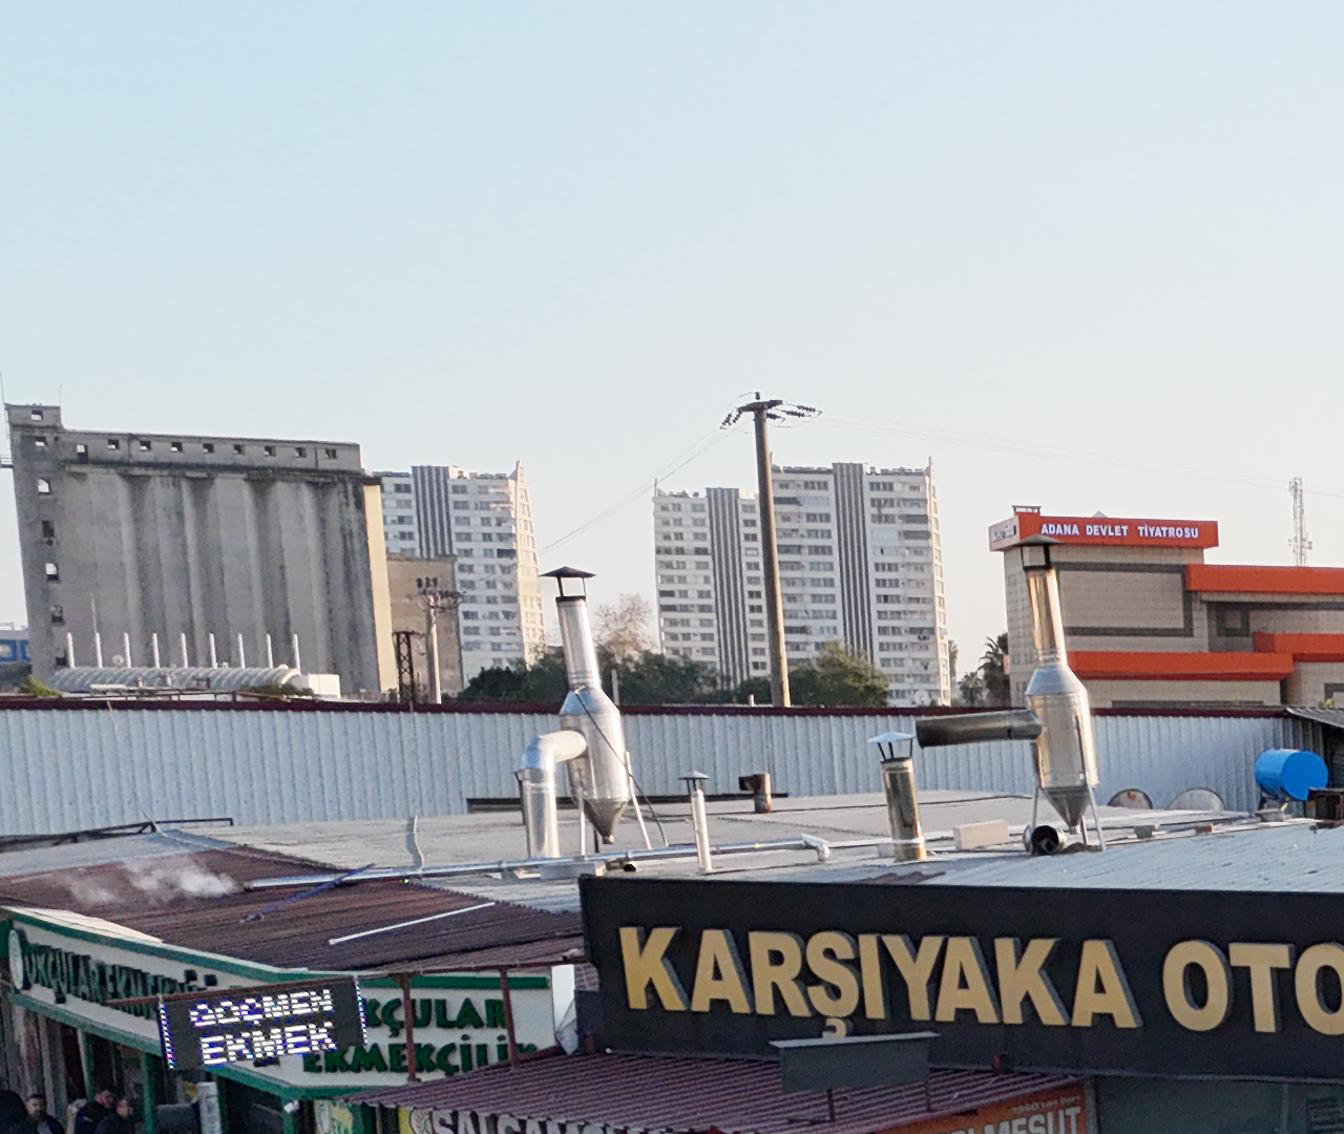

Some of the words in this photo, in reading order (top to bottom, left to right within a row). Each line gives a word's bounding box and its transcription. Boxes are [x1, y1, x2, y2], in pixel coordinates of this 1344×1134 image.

[1041, 523, 1080, 536] ADANA
[1086, 524, 1128, 537] DEVLET
[1138, 523, 1199, 539] TİYATROSU
[619, 926, 1143, 1038] KARŞIYAKA
[362, 997, 508, 1037] KÇULAR
[199, 1021, 338, 1065] EKMEK
